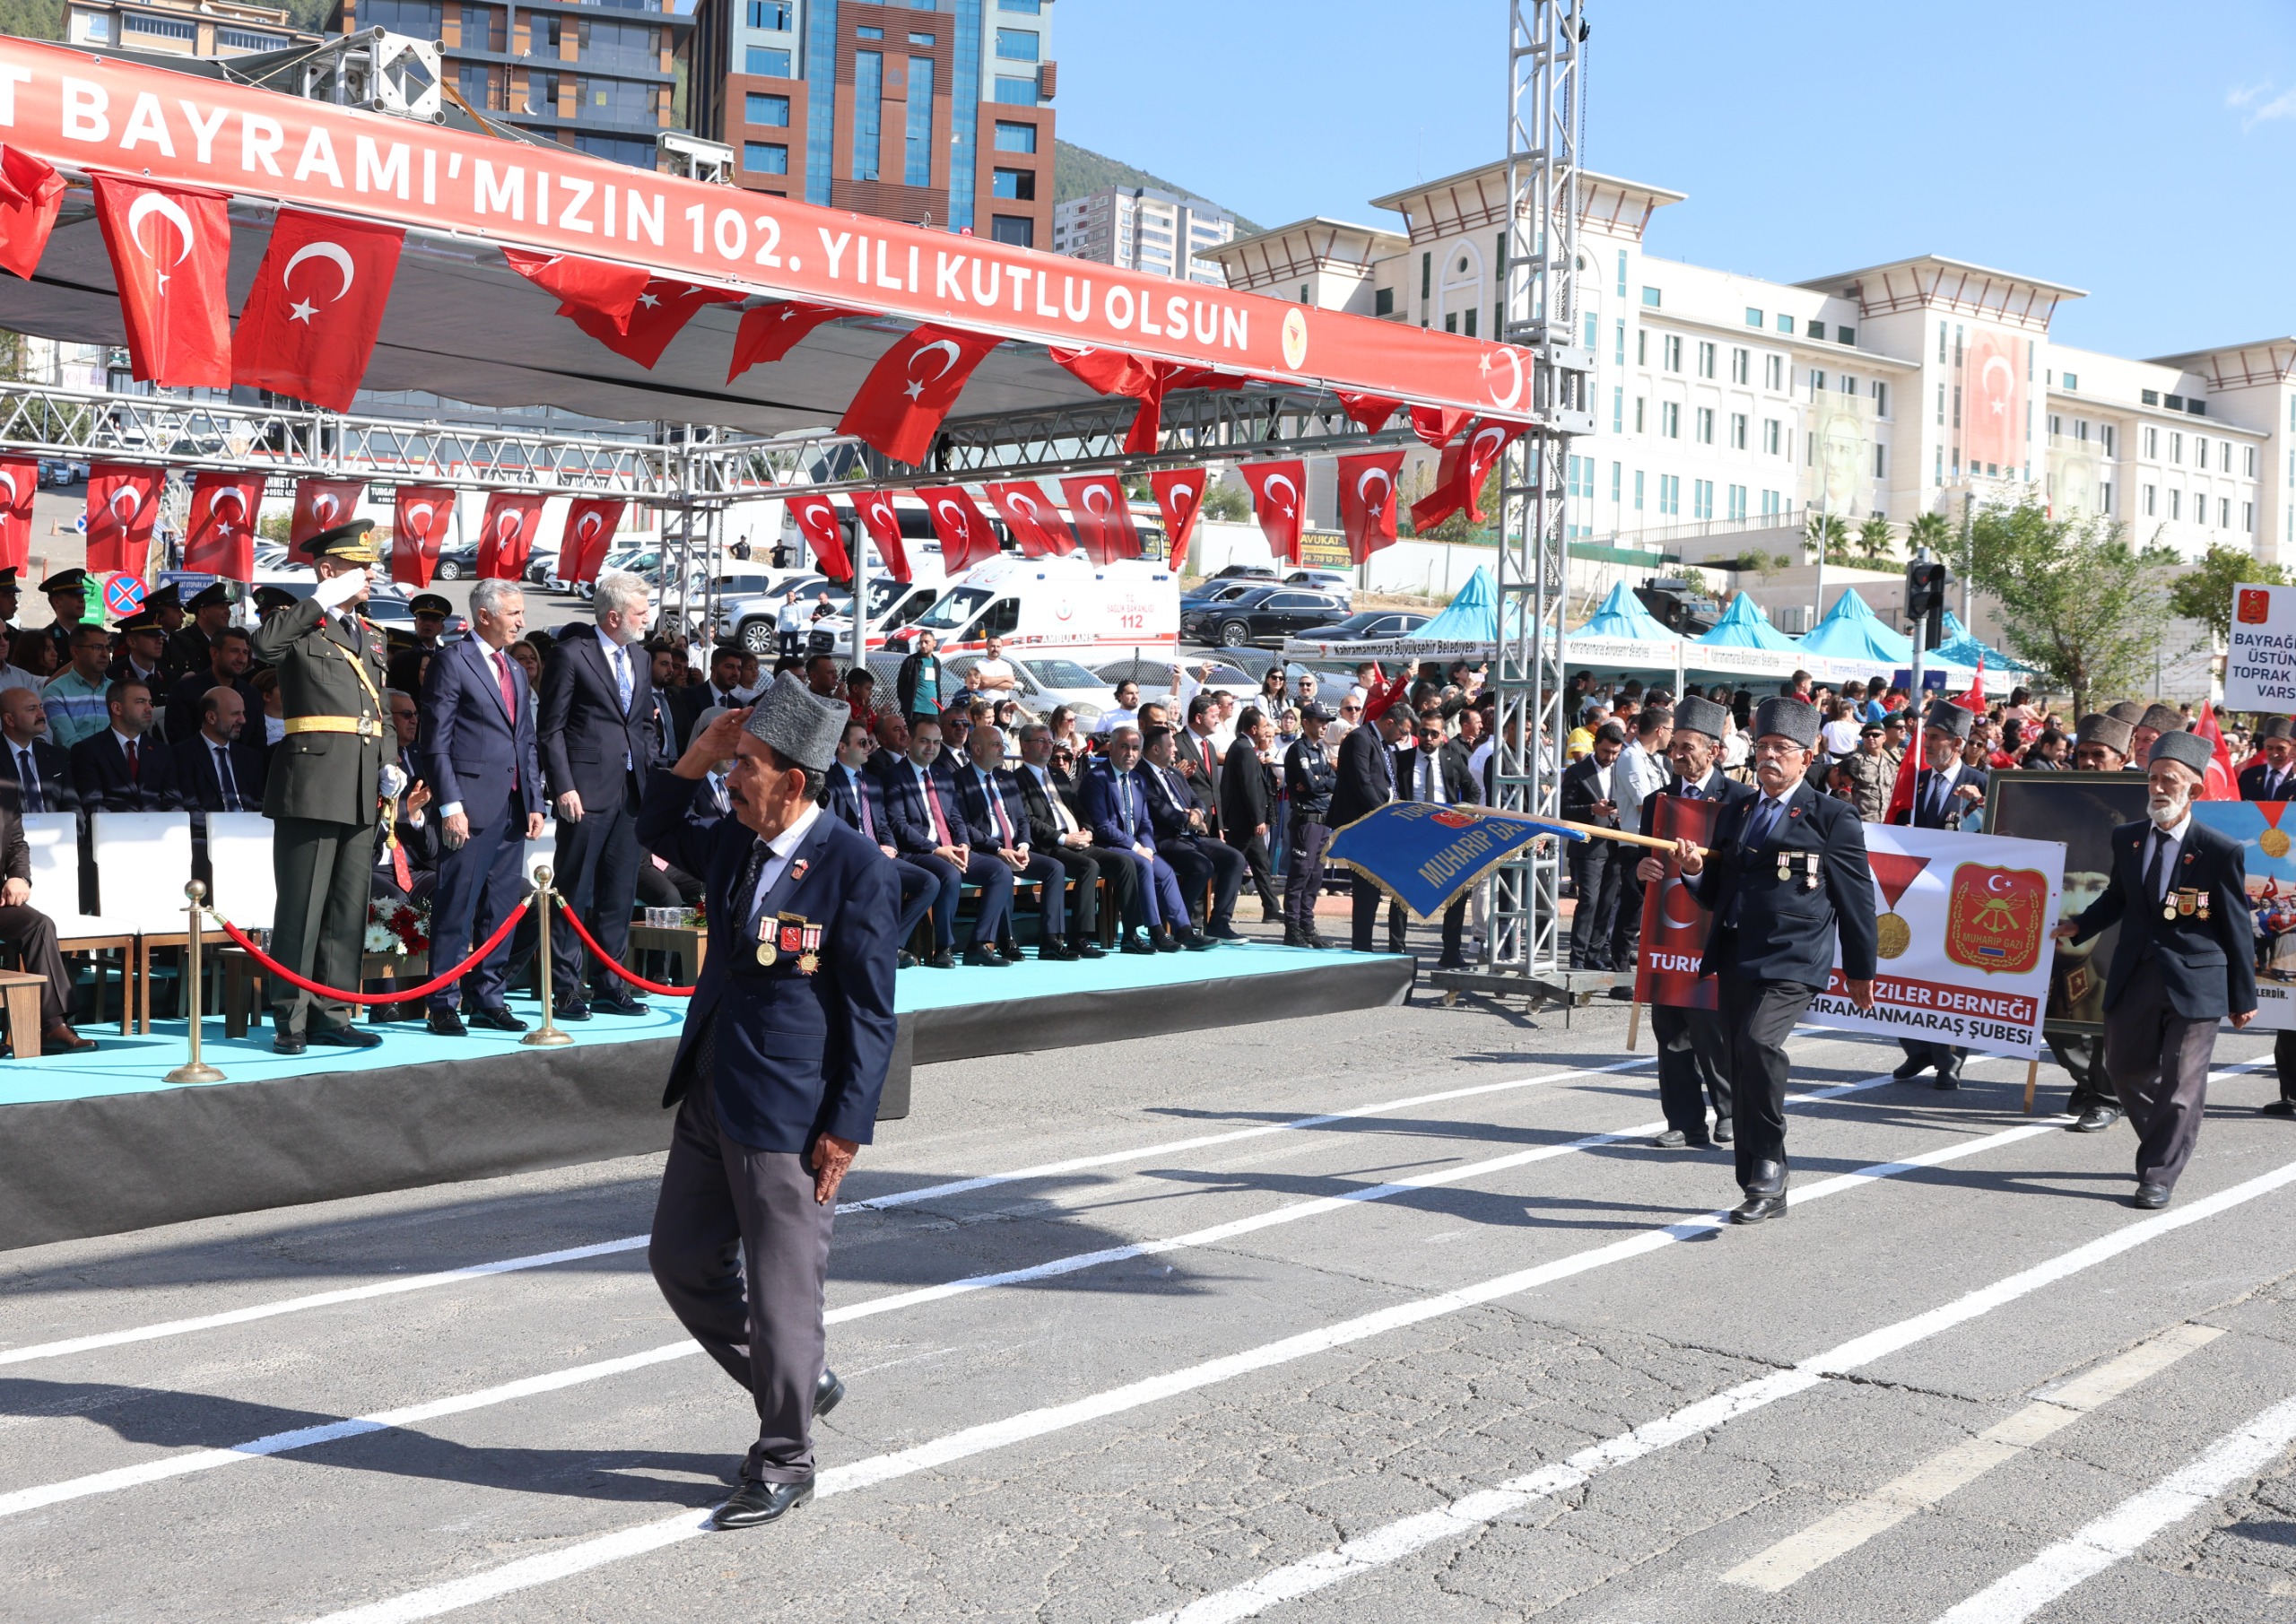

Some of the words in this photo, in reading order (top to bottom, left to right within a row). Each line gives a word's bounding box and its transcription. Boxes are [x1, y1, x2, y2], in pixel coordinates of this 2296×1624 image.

[685, 203, 801, 272] 102.
[818, 227, 919, 302] YILI
[936, 251, 1091, 323] KUTLU
[1105, 285, 1248, 351] OLSUN
[1300, 534, 1340, 545] AVUKAT
[1120, 614, 1144, 629] 112
[1042, 632, 1094, 644] AMBULANS
[1334, 644, 1394, 657] Kahramanmaraş
[1395, 640, 1436, 656] Büyükşehir
[1438, 640, 1476, 656] Belediyesi
[2232, 665, 2291, 682] TOPRAK
[2257, 684, 2296, 699] VARS
[1418, 831, 1493, 889] MUHARİP
[1962, 933, 2002, 946] MUHARİP
[2004, 938, 2023, 950] GAZİ
